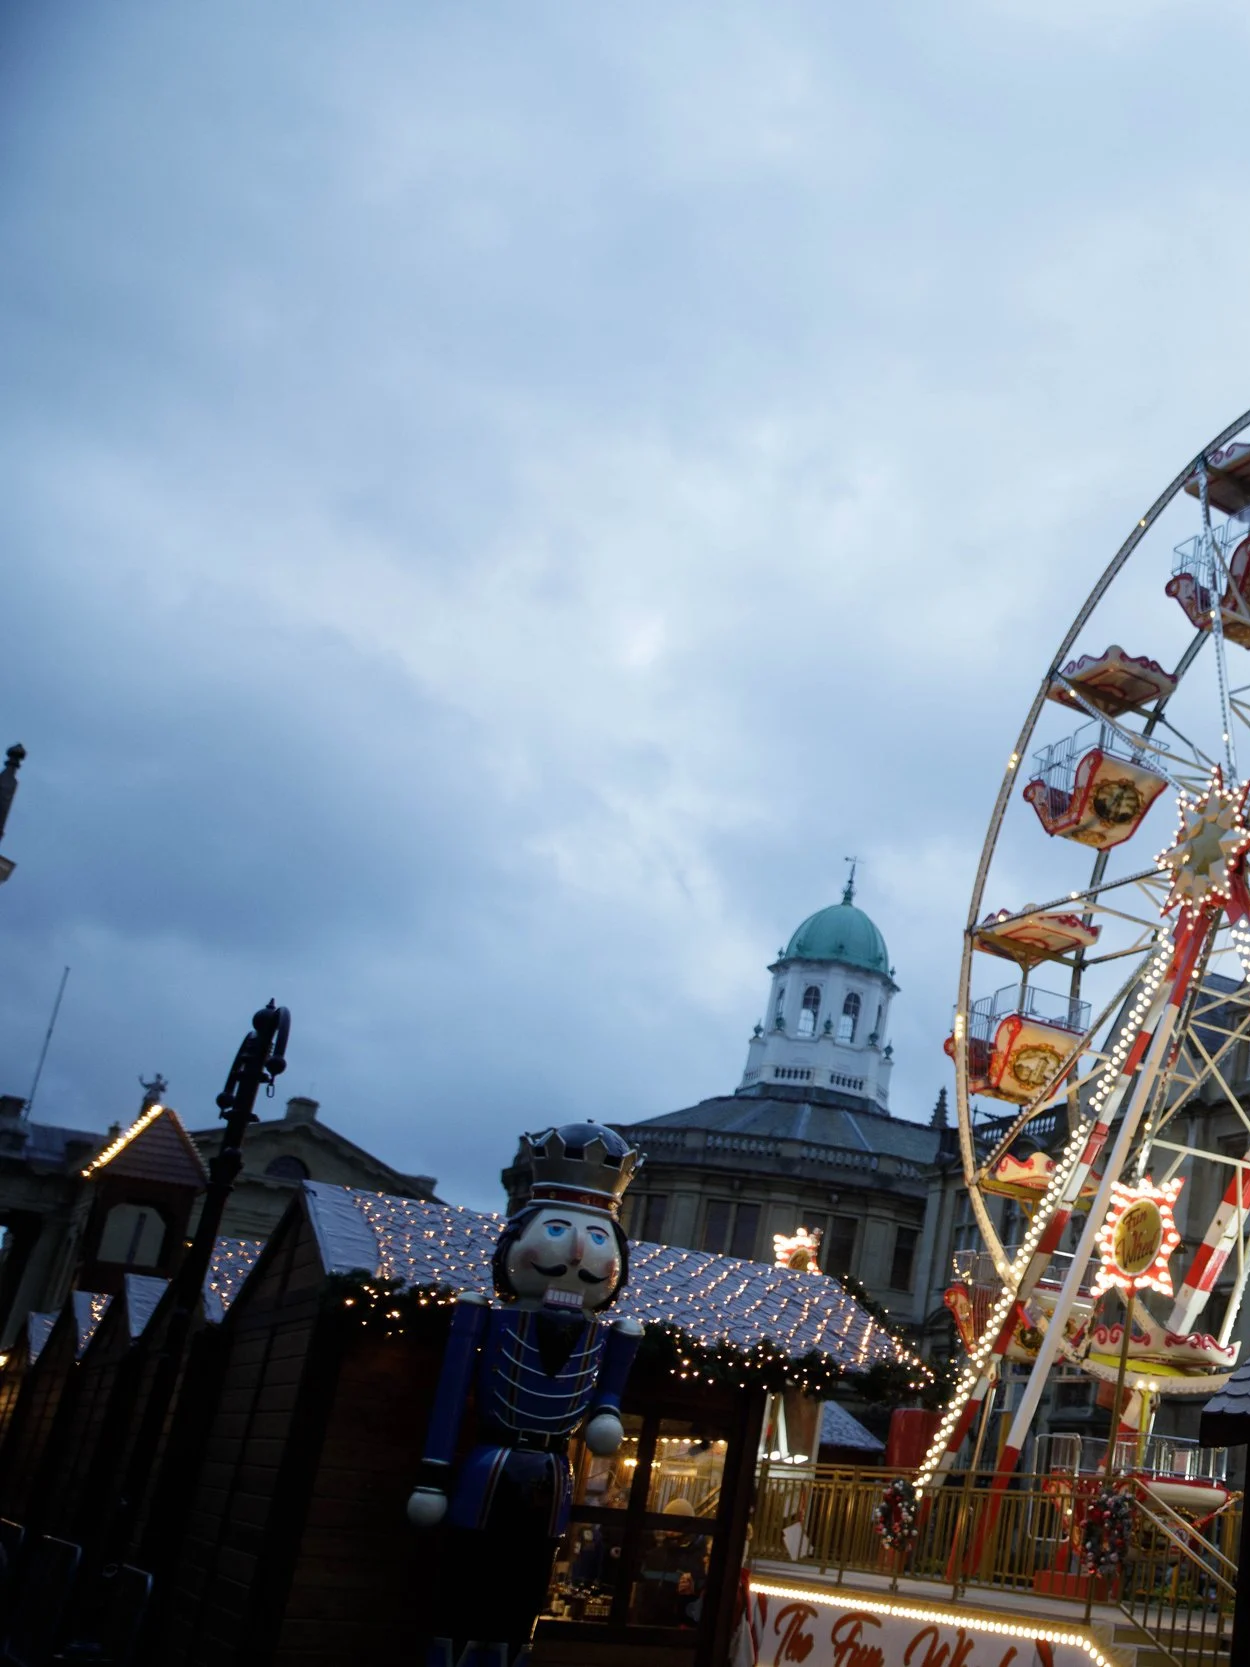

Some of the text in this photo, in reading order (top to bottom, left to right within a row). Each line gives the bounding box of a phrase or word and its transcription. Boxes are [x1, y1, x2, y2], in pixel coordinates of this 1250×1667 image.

[1122, 1207, 1148, 1232] Fun
[1115, 1227, 1161, 1269] Wheel
[774, 1602, 819, 1667] The
